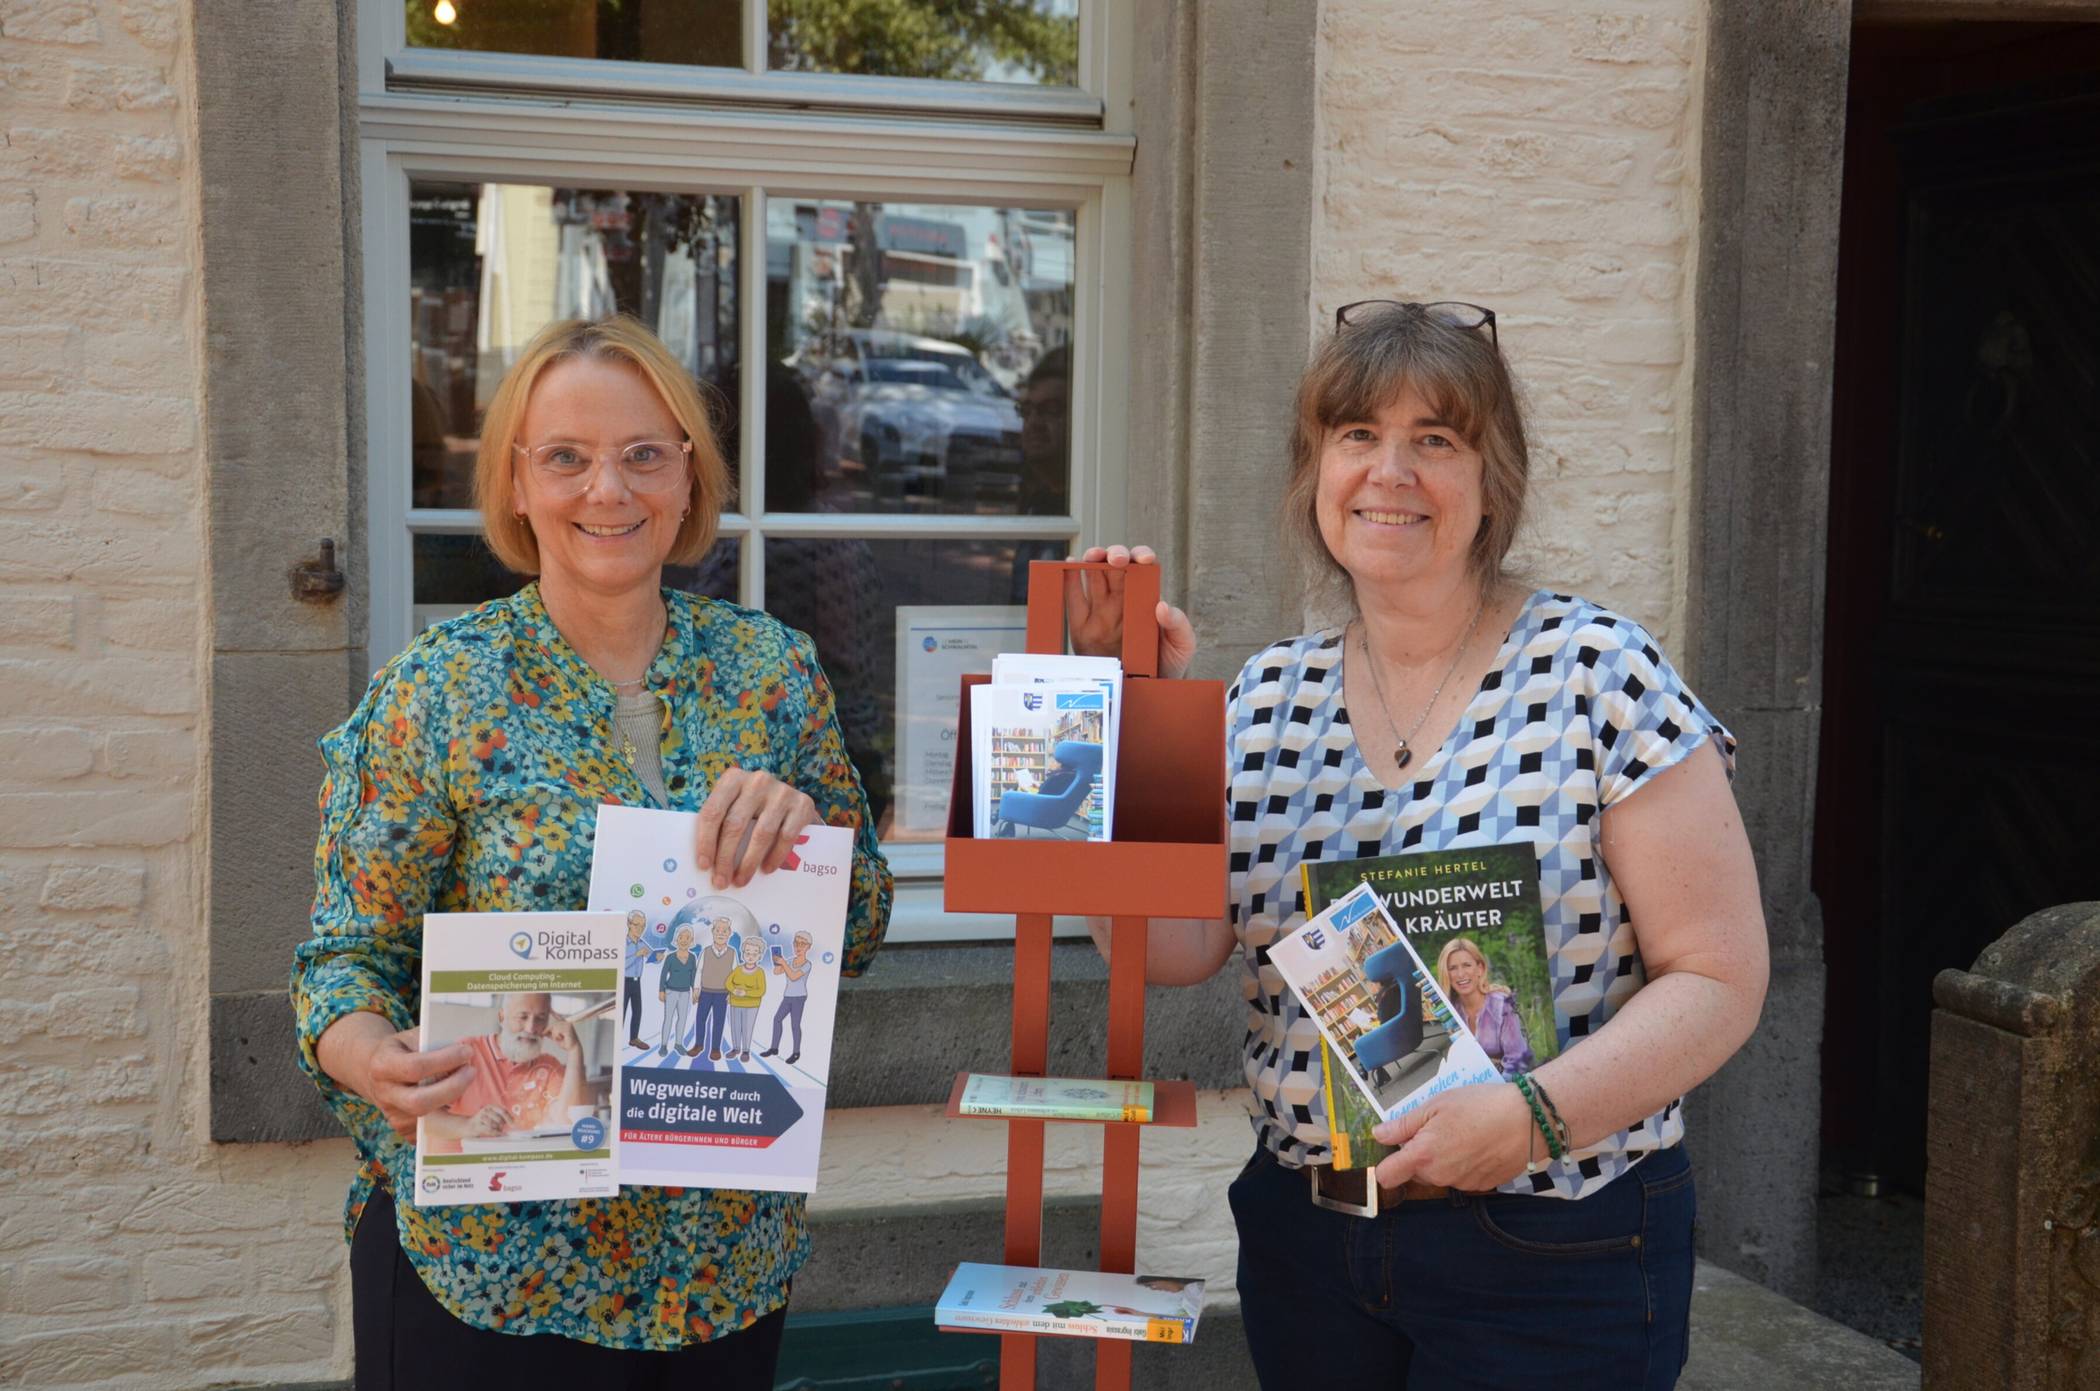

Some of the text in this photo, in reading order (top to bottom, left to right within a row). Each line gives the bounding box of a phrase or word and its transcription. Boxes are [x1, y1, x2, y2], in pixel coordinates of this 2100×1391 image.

[803, 860, 838, 877] bagso
[1360, 861, 1487, 881] STEFANIE HERTEL
[1405, 909, 1502, 934] KRÄUTER
[538, 930, 591, 948] Digital
[545, 946, 618, 963] Kompass
[467, 980, 582, 990] Datenspeicherung im Internet
[488, 973, 511, 981] Cloud
[513, 973, 555, 982] Computing
[629, 1079, 761, 1102] Wegweiser durch
[626, 1103, 763, 1124] die digitale Welt
[580, 1135, 595, 1144] #9
[623, 1132, 758, 1146] FÜR ÄLTERE BÜRGERINNEN UND BÜRGER
[1032, 1321, 1050, 1330] dem
